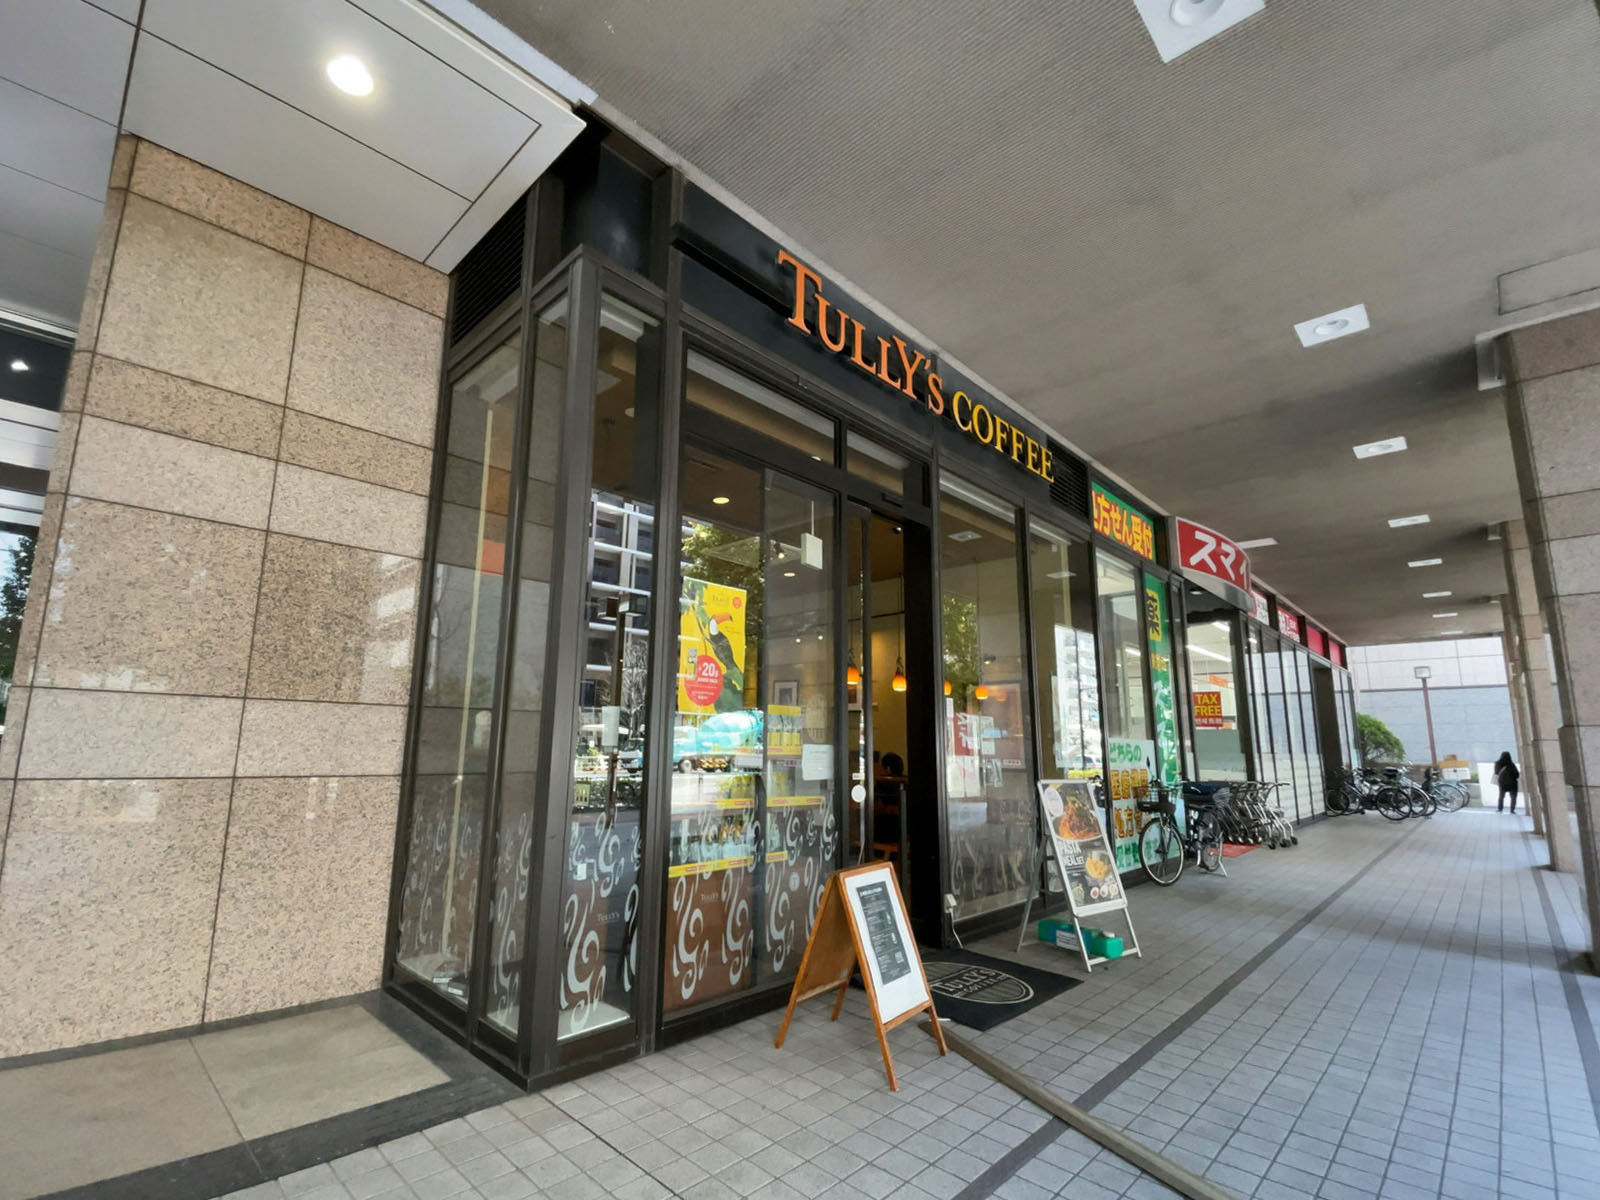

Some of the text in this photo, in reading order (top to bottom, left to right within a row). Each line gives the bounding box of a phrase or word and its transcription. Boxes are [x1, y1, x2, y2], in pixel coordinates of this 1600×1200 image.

[952, 390, 1054, 483] COFFEE
[1195, 694, 1218, 705] TAX
[1194, 705, 1221, 716] FREE
